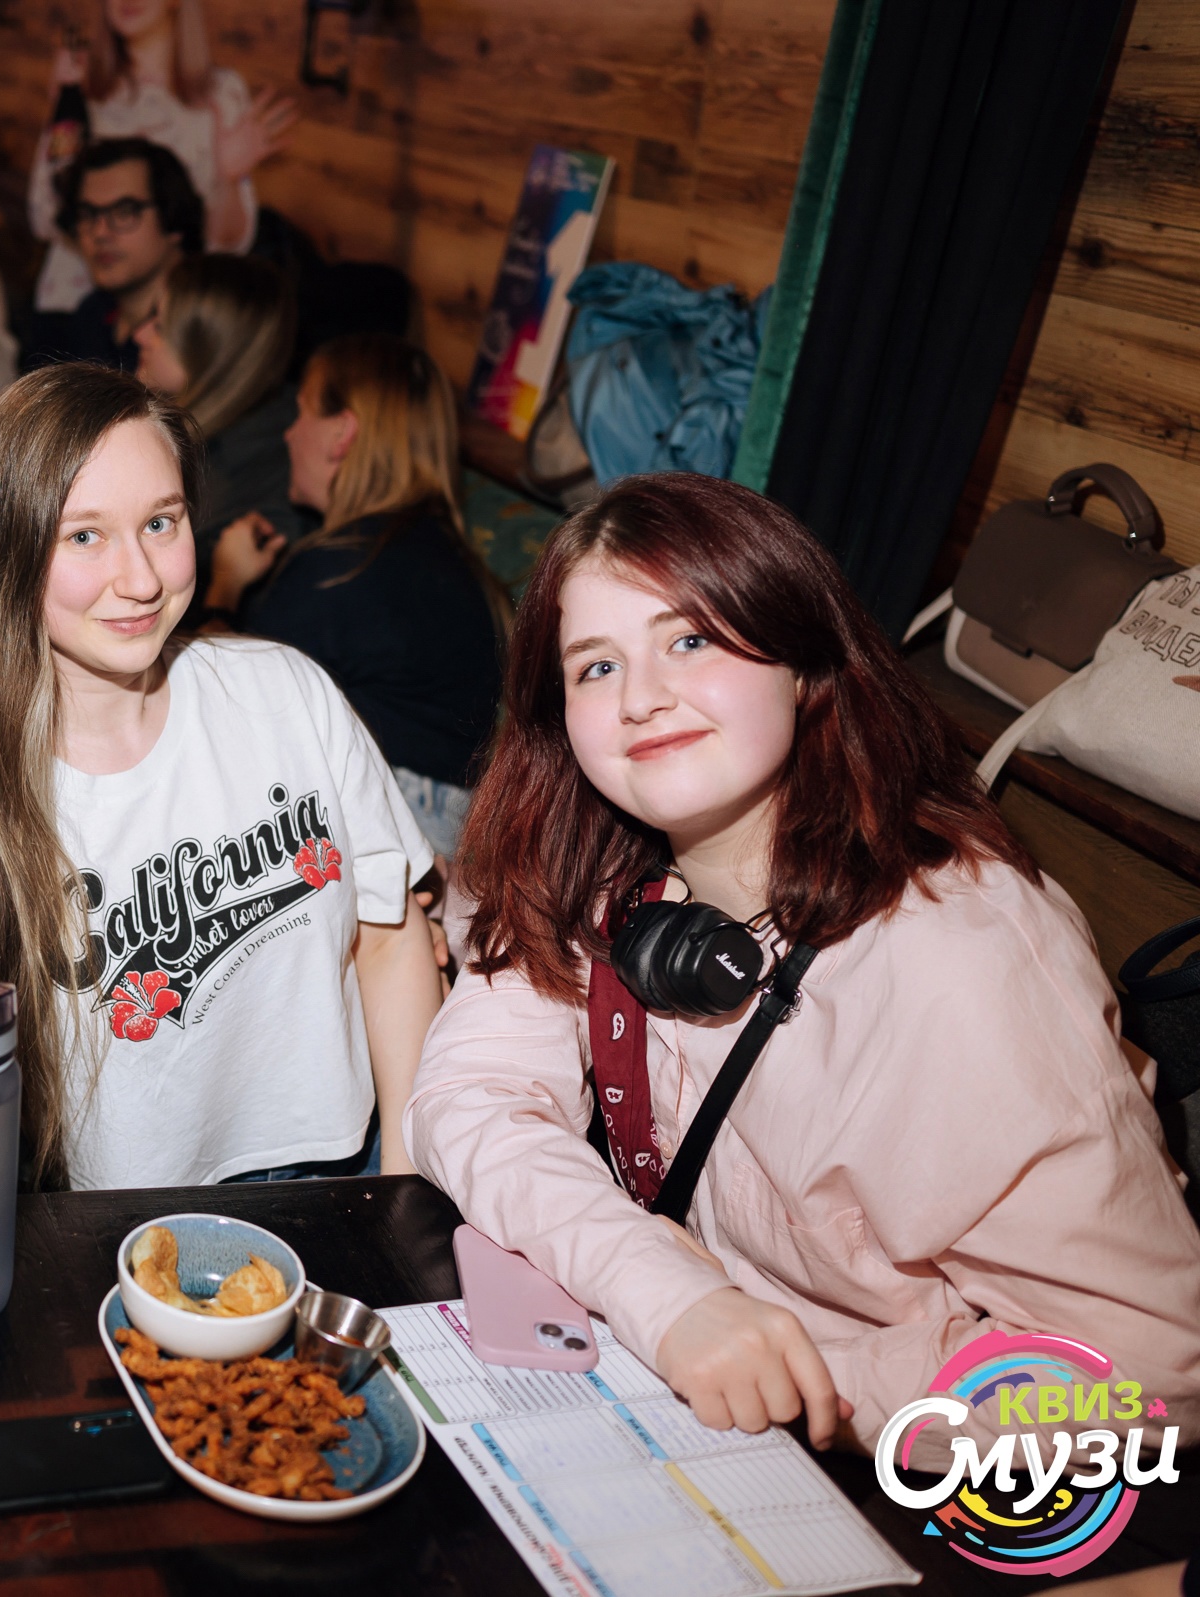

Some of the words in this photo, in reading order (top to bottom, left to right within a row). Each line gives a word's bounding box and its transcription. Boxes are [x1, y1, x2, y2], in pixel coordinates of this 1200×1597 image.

[155, 919, 229, 988] Sunset
[230, 896, 275, 931] lovers
[192, 993, 217, 1026] West
[213, 956, 244, 991] Coast
[243, 911, 312, 957] Dreaming
[715, 953, 746, 980] Marshall
